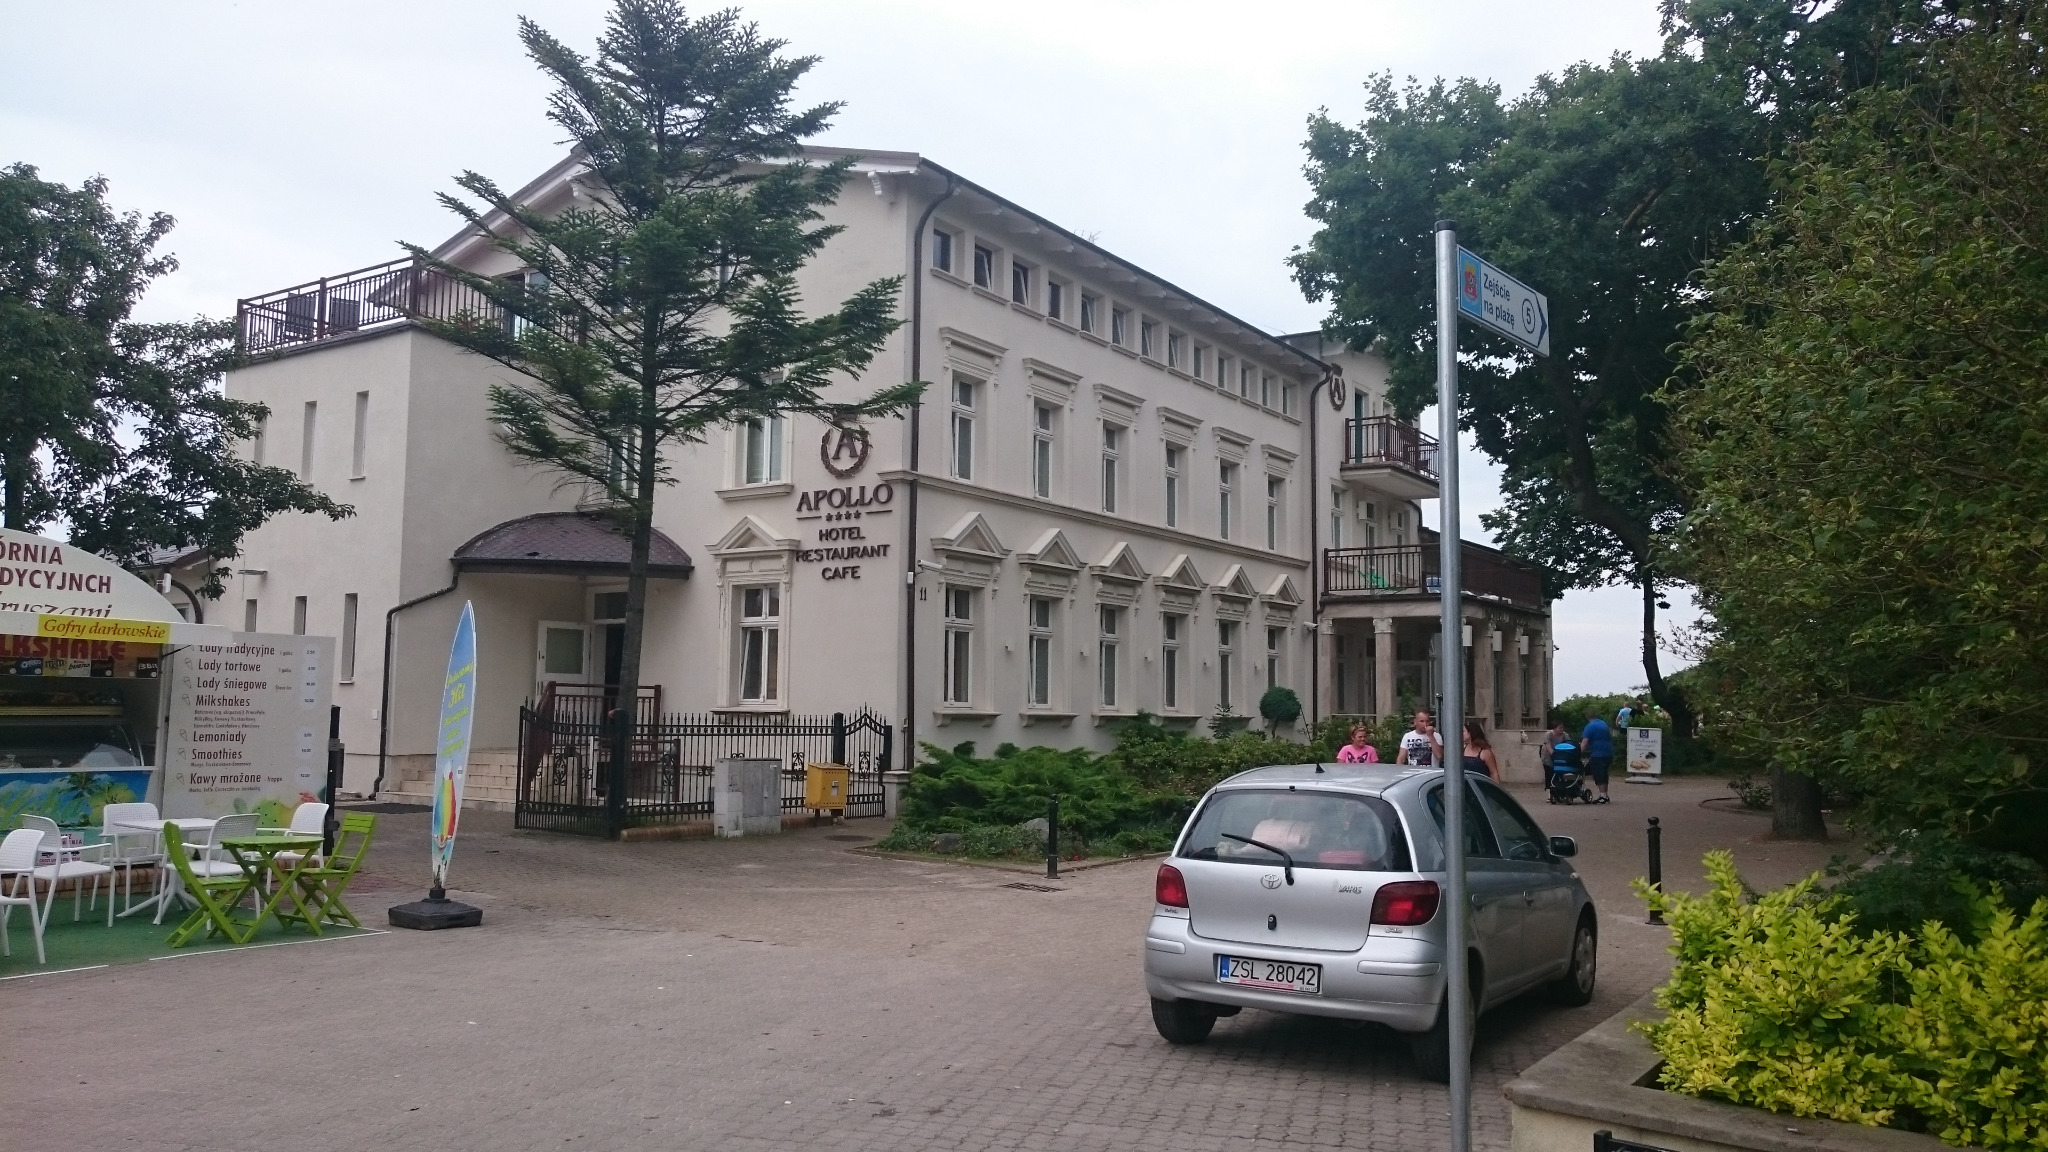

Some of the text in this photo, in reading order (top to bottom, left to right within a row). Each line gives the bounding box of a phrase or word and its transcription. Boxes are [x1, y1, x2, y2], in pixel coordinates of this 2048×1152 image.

[1483, 272, 1511, 302] Zejście
[1483, 299, 1515, 330] na plażę
[1526, 306, 1532, 325] 5
[796, 483, 894, 512] APOLLO
[818, 526, 866, 541] HOTEL
[795, 544, 891, 563] RESTAURANT
[821, 566, 861, 580] CAFE
[919, 586, 927, 601] 11
[44, 619, 166, 639] Gofry darłowskie
[198, 659, 222, 673] Lody
[225, 661, 261, 672] tortowe
[197, 677, 221, 691] Lody
[224, 678, 267, 691] śniegowe
[195, 695, 250, 707] Milkshakes
[193, 731, 247, 744] Lemoniady
[192, 748, 243, 760] Smoothies
[190, 772, 217, 786] Kawy
[220, 773, 262, 783] mrożone
[1230, 959, 1260, 980] ZSL
[1265, 963, 1316, 986] 28042
